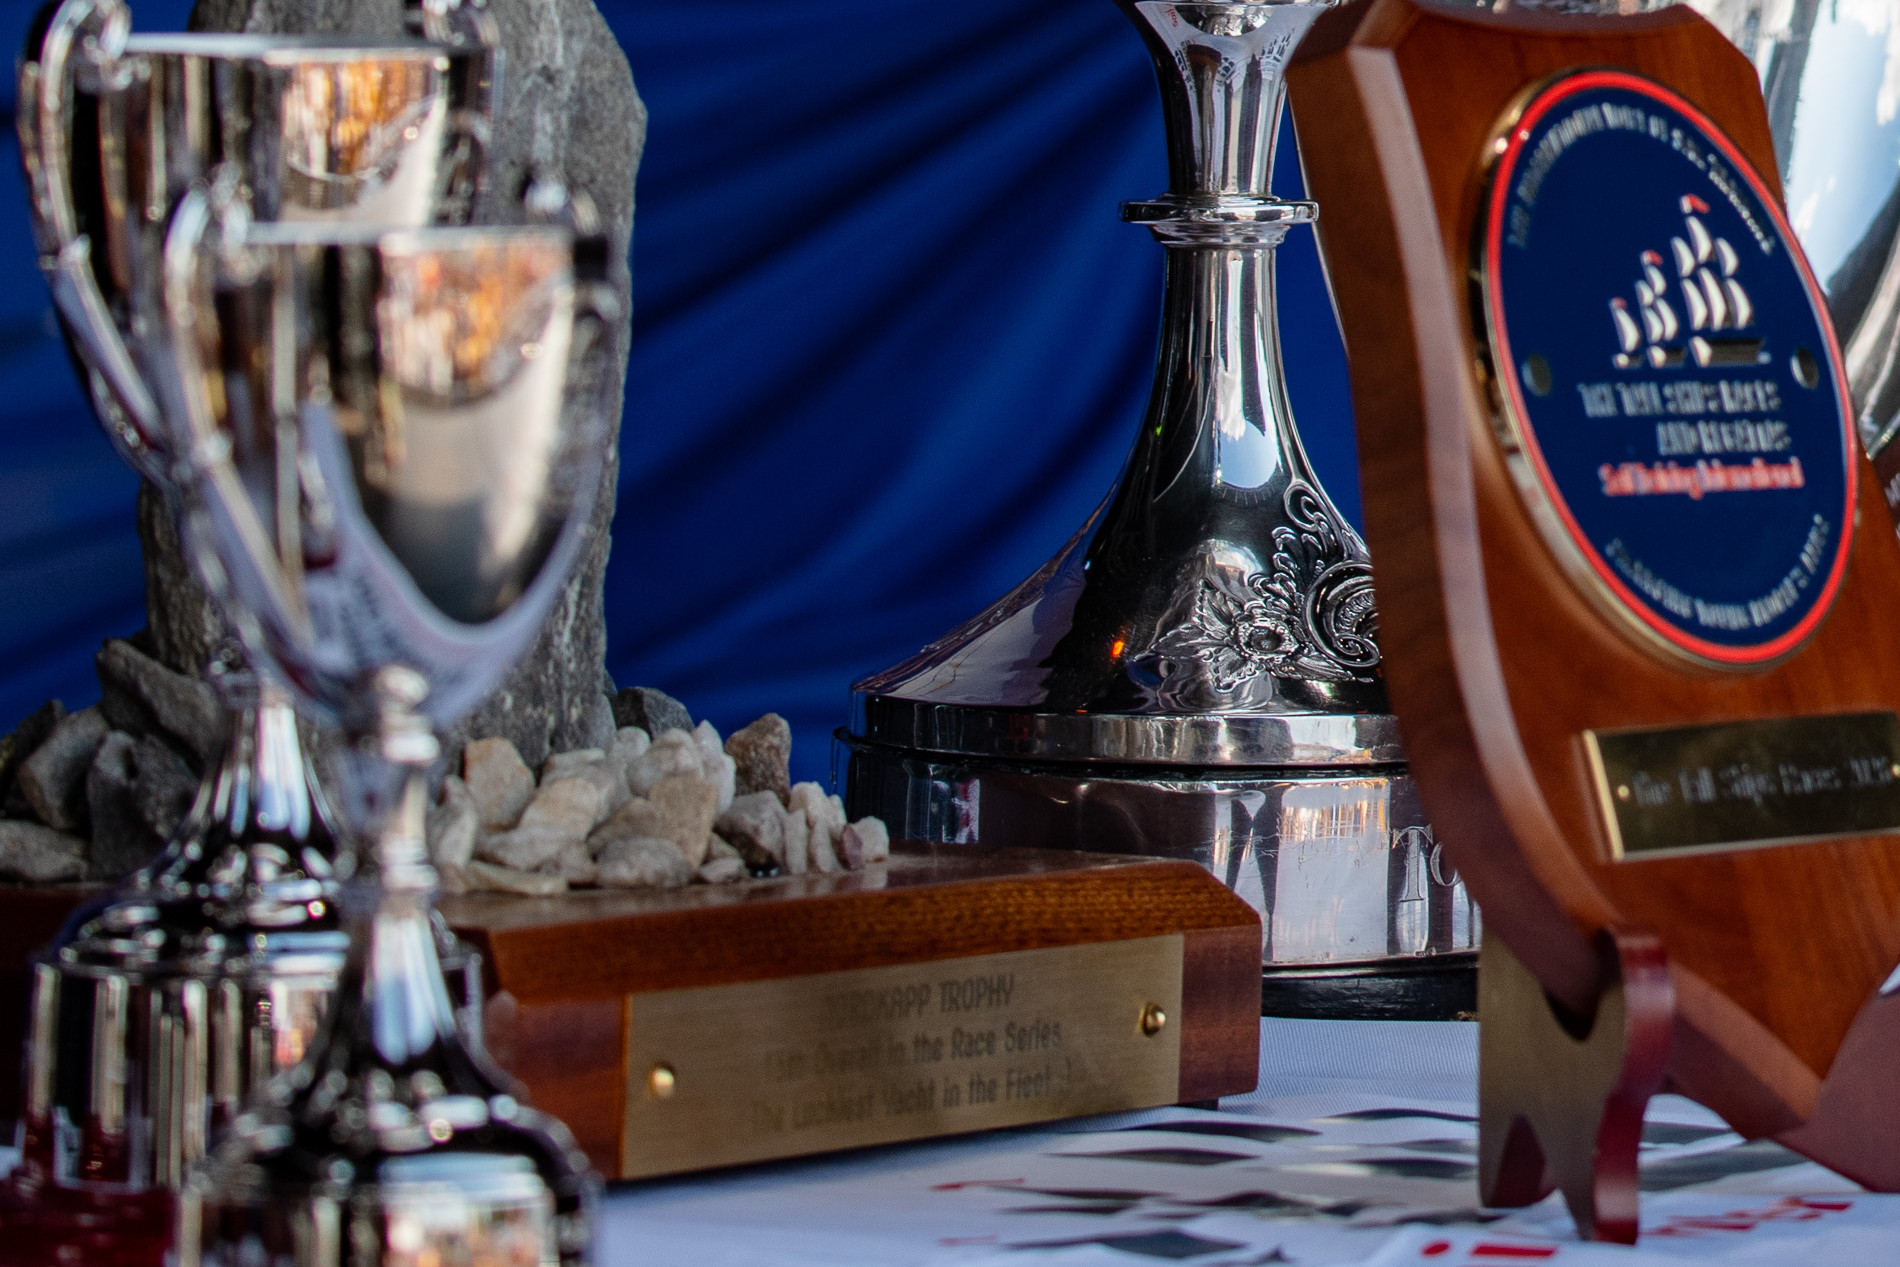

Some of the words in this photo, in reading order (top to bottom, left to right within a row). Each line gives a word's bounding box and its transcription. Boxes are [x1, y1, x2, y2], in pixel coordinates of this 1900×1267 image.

[950, 1027, 996, 1060] Race
[1004, 1020, 1062, 1054] Series
[967, 1073, 997, 1106] the
